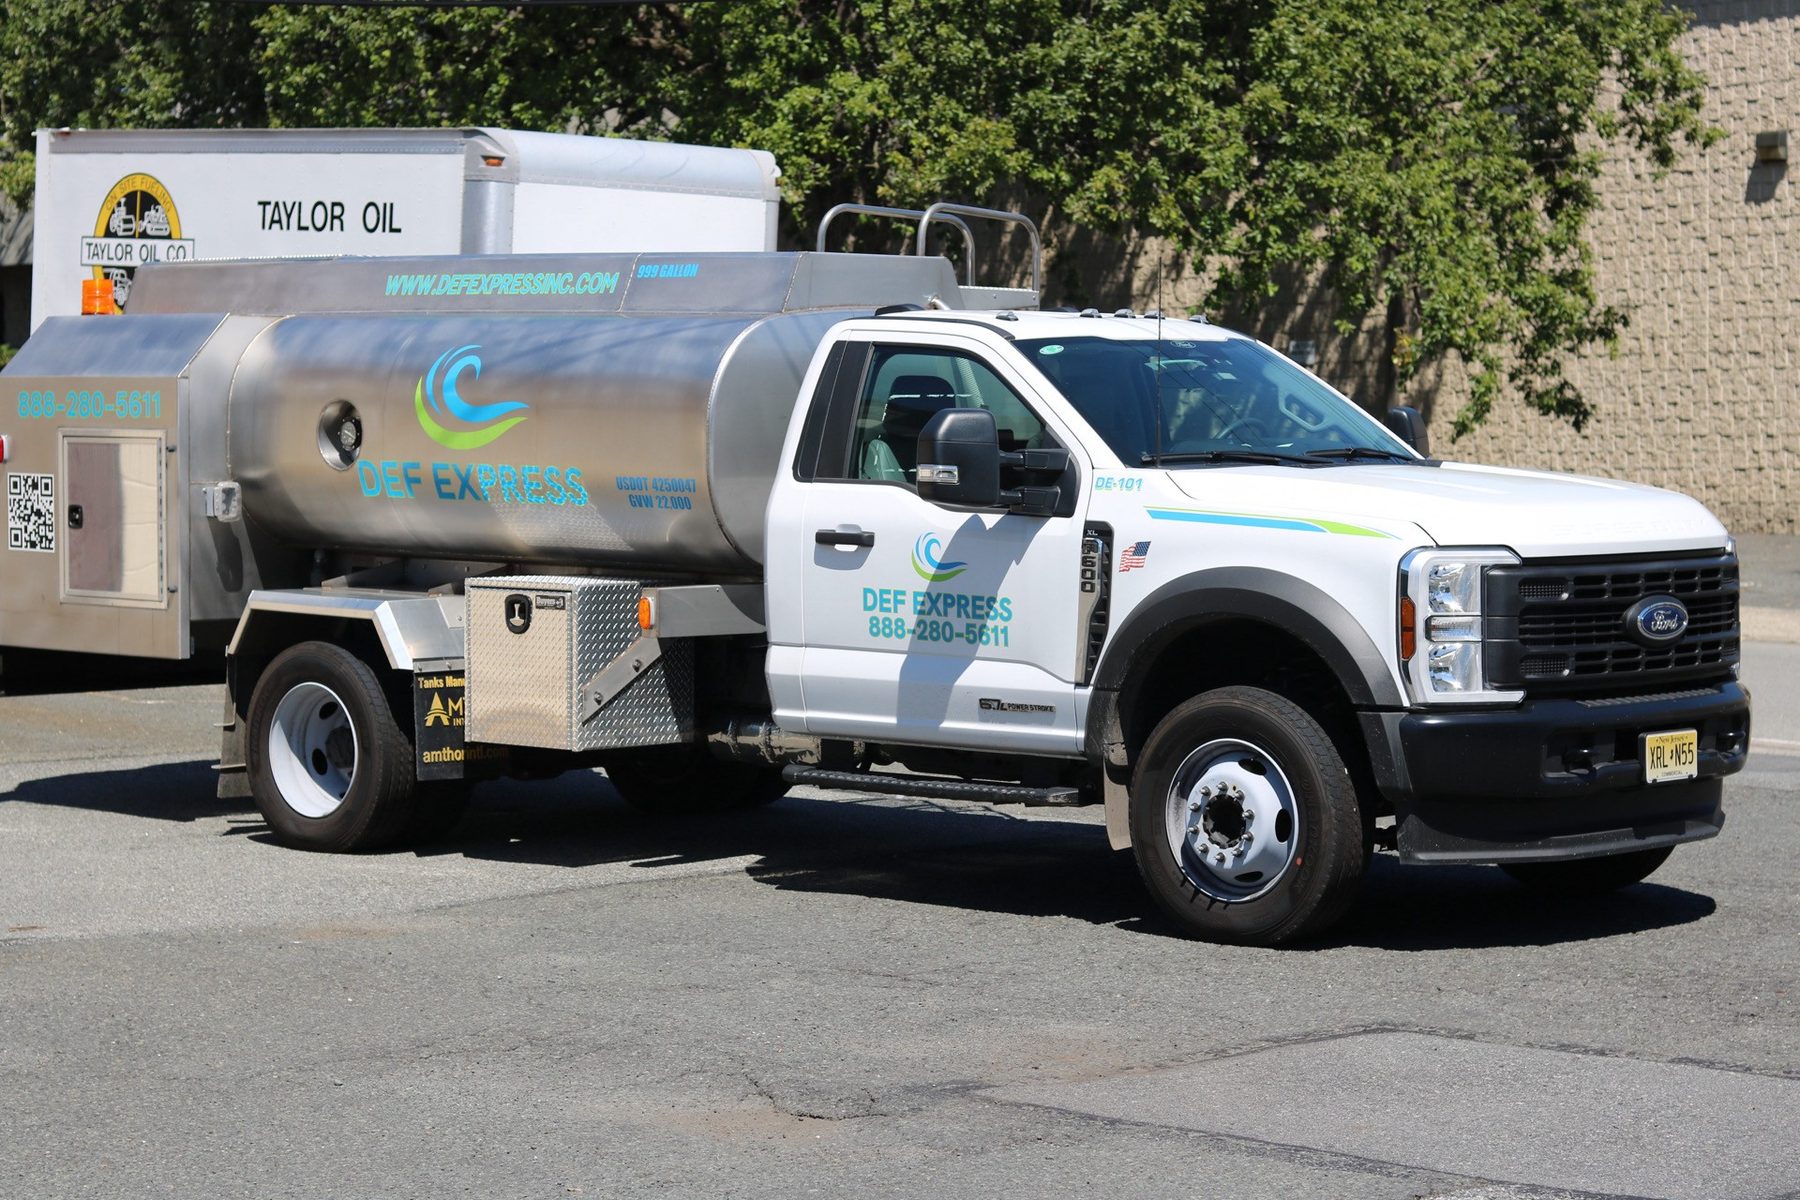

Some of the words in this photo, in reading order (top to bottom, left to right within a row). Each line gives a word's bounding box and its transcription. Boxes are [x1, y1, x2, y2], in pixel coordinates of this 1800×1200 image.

[120, 178, 137, 193] SITE
[140, 177, 171, 213] FUELING
[257, 200, 345, 233] TAYLOR
[362, 201, 402, 234] OIL
[86, 242, 133, 261] TAYLOR
[139, 244, 160, 262] OIL
[166, 244, 187, 261] CO
[384, 271, 620, 297] WWW.DEFEXPRESSINC.COM
[637, 264, 658, 279] 999
[658, 263, 699, 278] GALLON
[18, 390, 161, 418] 888-280-5611
[357, 459, 422, 498] DEF
[431, 462, 589, 506] EXPRESS
[616, 475, 649, 491] USDOT
[652, 477, 697, 493] 4250047
[1095, 477, 1144, 491] DE-101
[628, 494, 654, 508] GVW
[862, 587, 907, 613] DEF
[912, 591, 1013, 623] EXPRESS
[868, 615, 1010, 648] 888-280-5611
[1651, 611, 1679, 631] Ford
[418, 676, 444, 689] Tanks
[1650, 745, 1668, 769] XRL
[1675, 742, 1694, 767] N55
